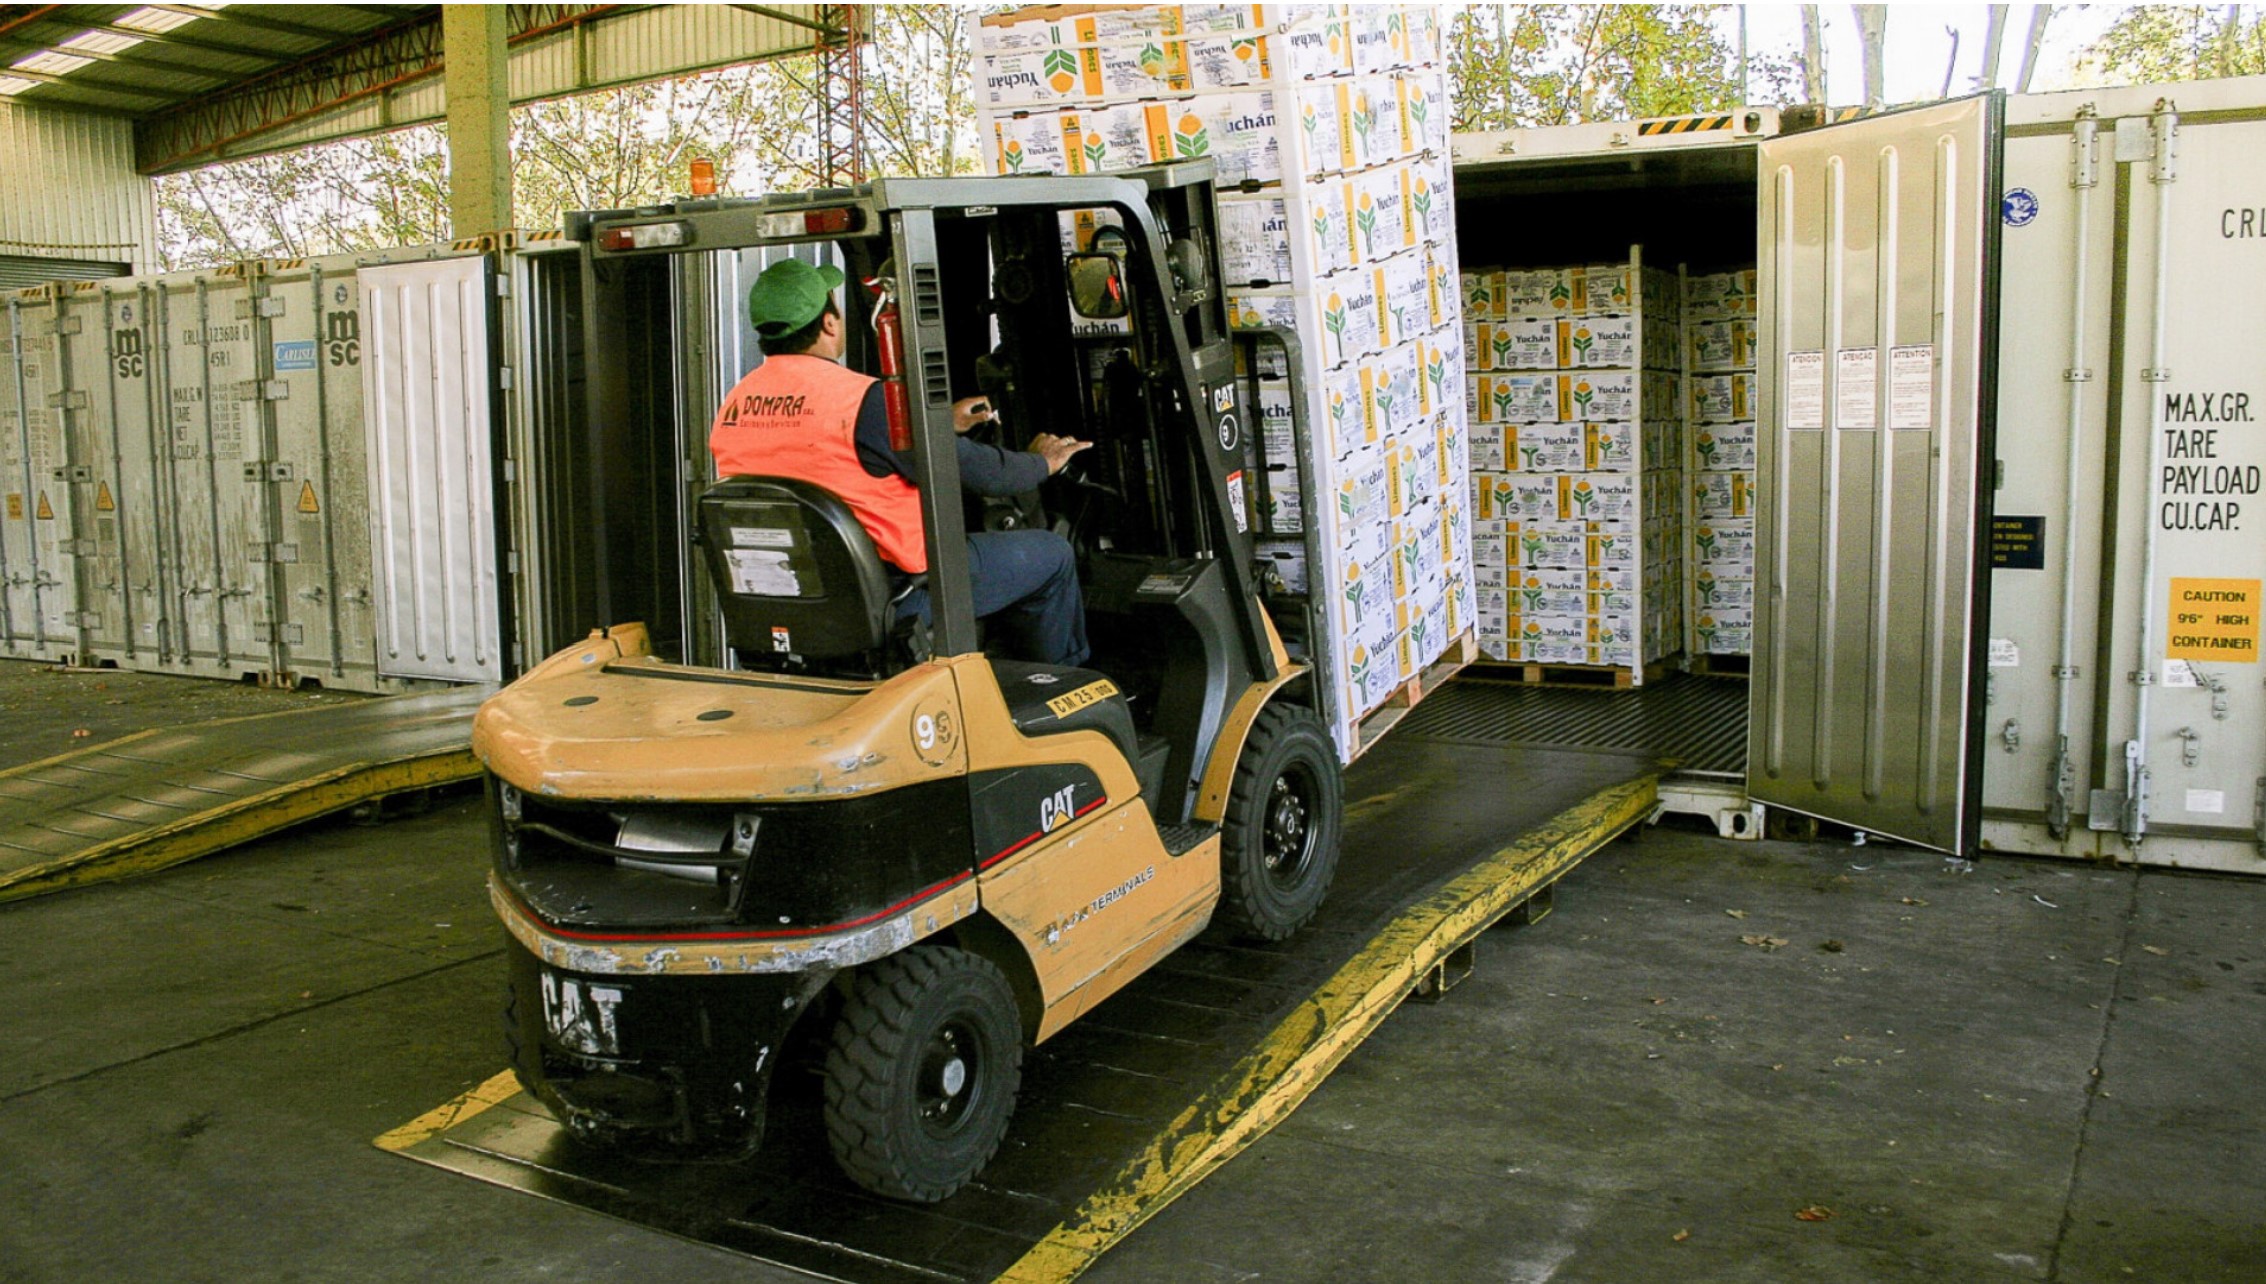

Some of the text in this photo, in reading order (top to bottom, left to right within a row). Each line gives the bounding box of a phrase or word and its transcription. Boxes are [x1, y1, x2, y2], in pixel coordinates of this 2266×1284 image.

[1226, 113, 1277, 133] uchán
[743, 395, 806, 418] DOMPRA
[1214, 384, 1235, 411] CAT
[2165, 393, 2255, 422] MAX.GR.
[2165, 430, 2218, 458] TARE
[2162, 465, 2260, 494] PAYLOAD
[2183, 590, 2246, 603] CAUTION
[2216, 614, 2249, 626] HIGH
[2172, 636, 2252, 650] CONTAINER
[1041, 784, 1076, 832] CAT
[1090, 865, 1155, 914] TERMINALS
[541, 972, 623, 1055] CAT
